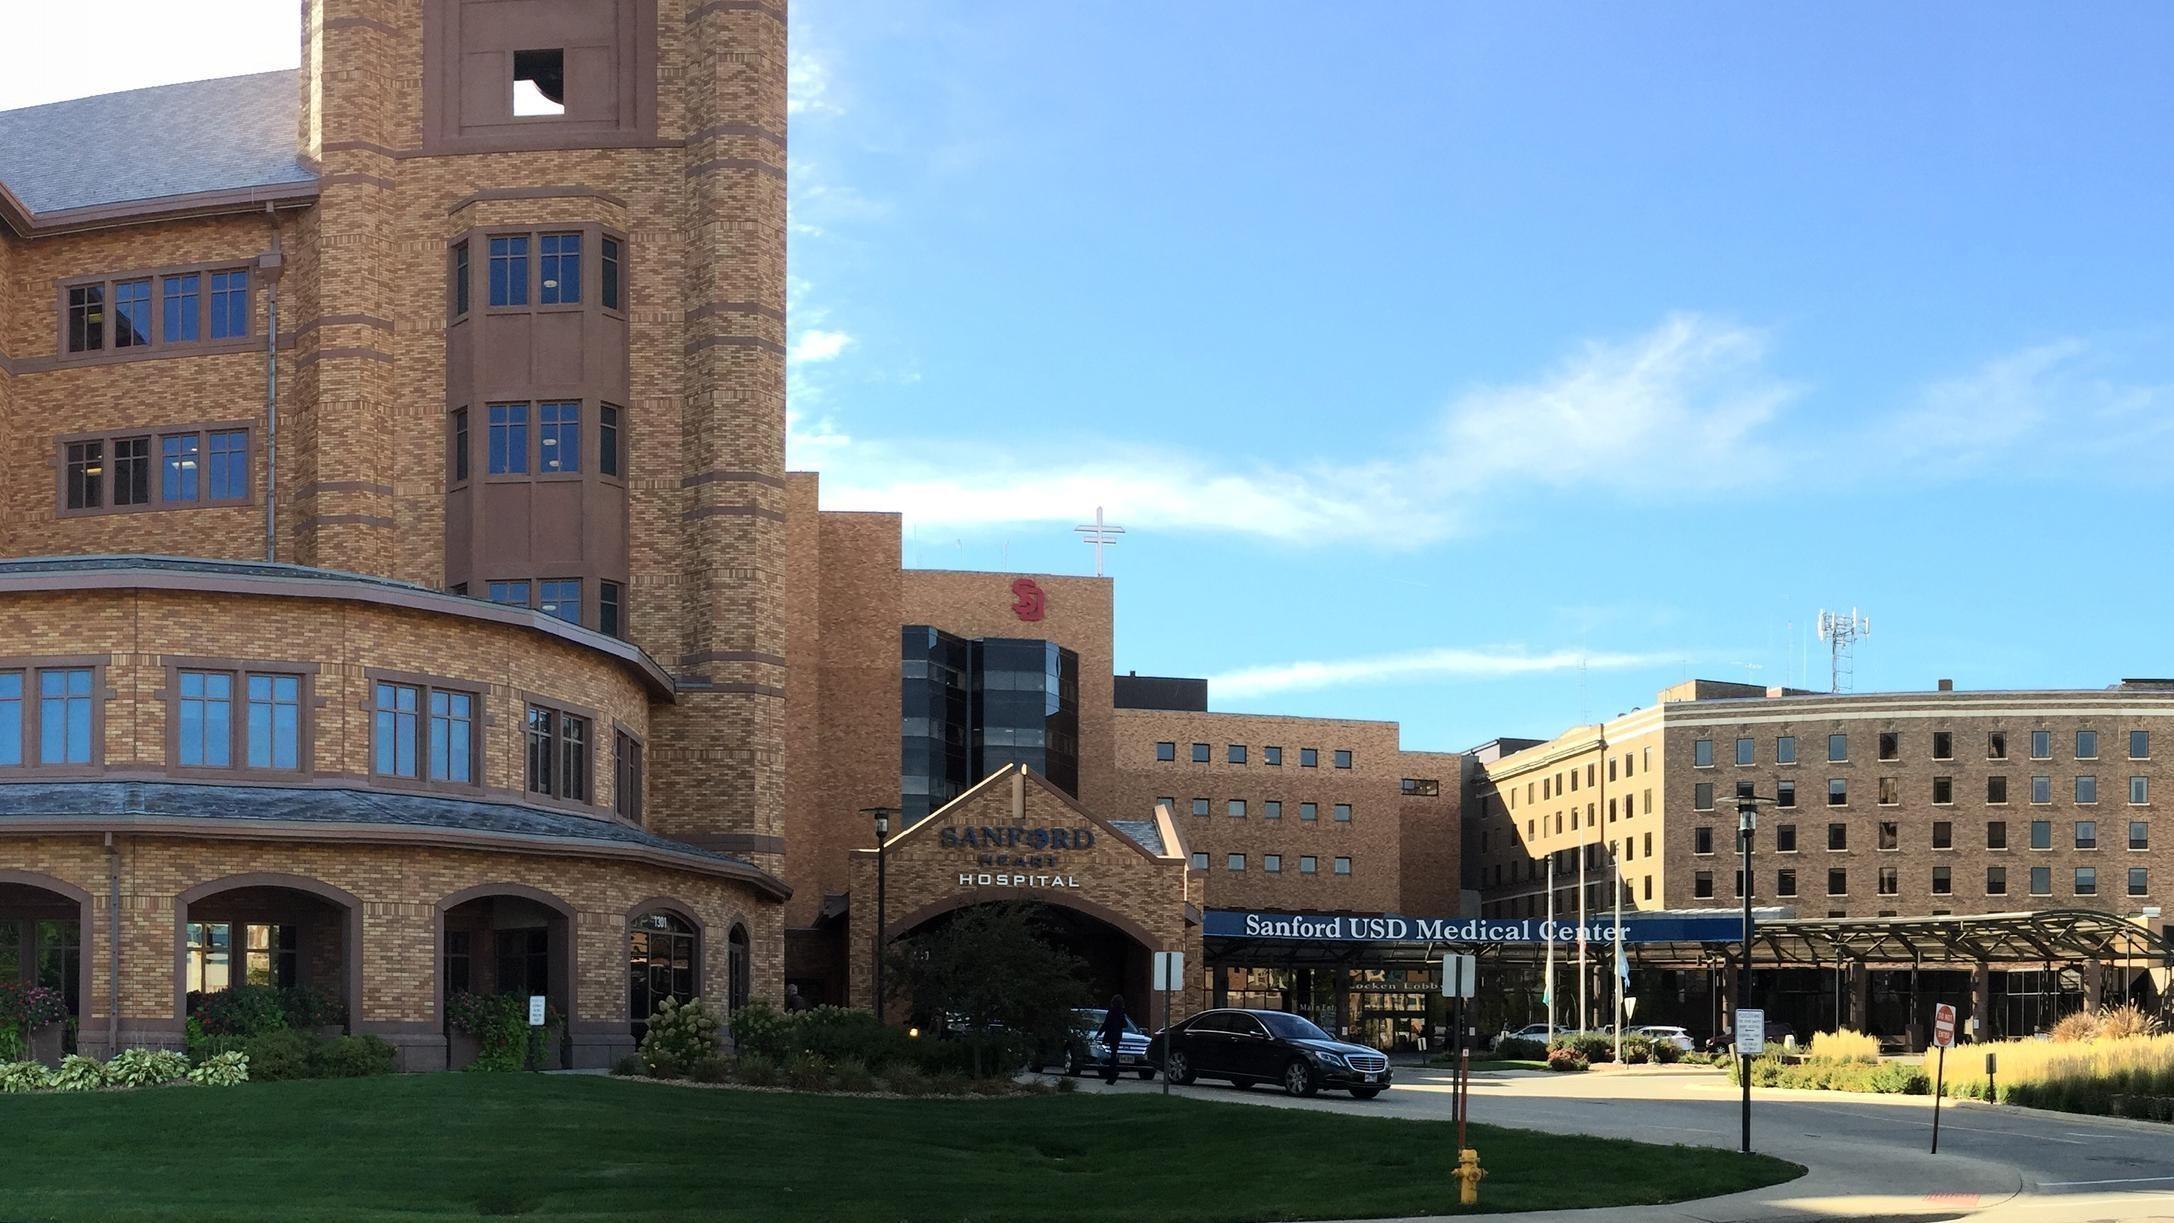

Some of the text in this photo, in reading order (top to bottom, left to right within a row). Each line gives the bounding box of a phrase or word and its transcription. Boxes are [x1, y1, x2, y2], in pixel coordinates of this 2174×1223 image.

[941, 826, 1095, 849] SANFORD
[980, 854, 1056, 867] HEART
[959, 873, 1079, 887] HOSPITAL
[1246, 914, 1631, 941] Sanford USD Medical Center
[1404, 982, 1443, 990] Lobb
